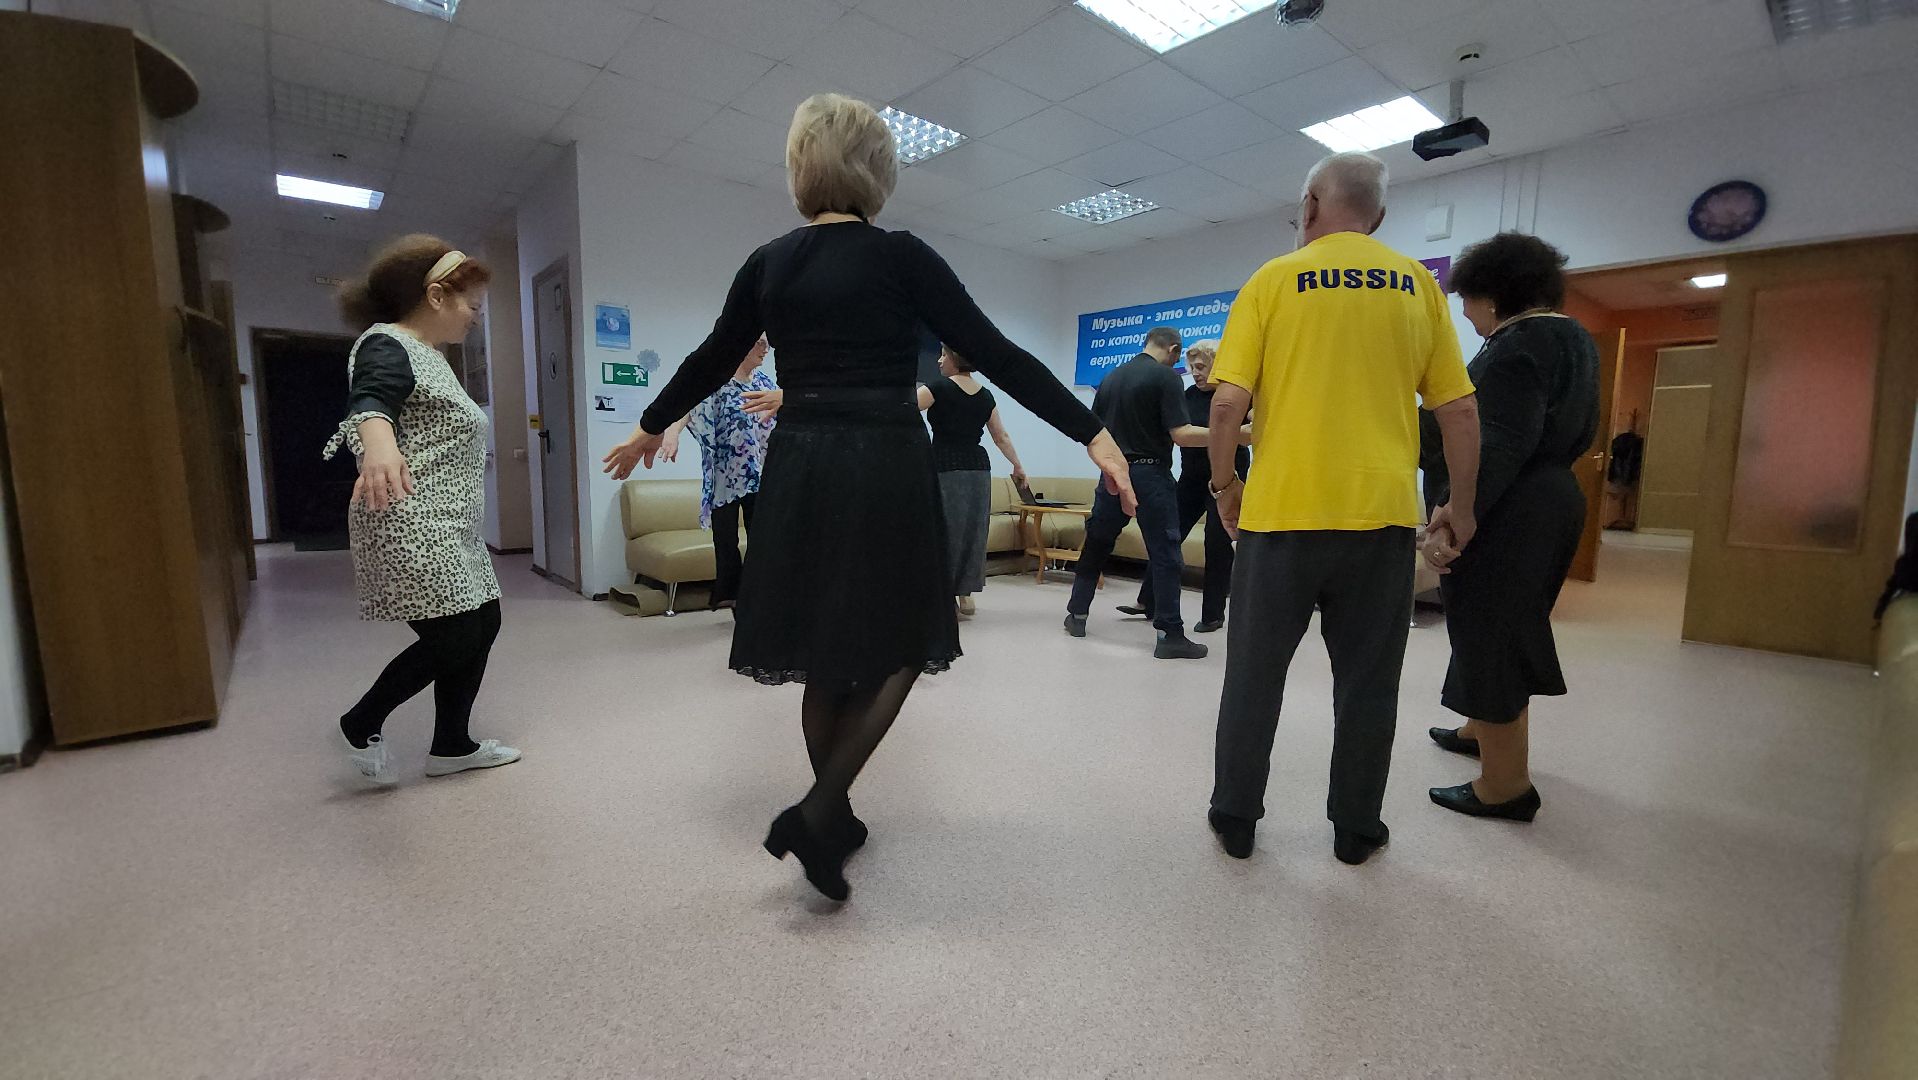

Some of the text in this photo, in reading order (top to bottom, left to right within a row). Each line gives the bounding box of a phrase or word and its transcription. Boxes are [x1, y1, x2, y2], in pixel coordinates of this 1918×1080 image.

[1297, 268, 1416, 297] RUSSIA
[1091, 314, 1144, 333] Музыка
[1154, 308, 1184, 322] это
[1090, 338, 1106, 349] по
[1107, 333, 1148, 348] котор
[1089, 352, 1137, 369] вернут
